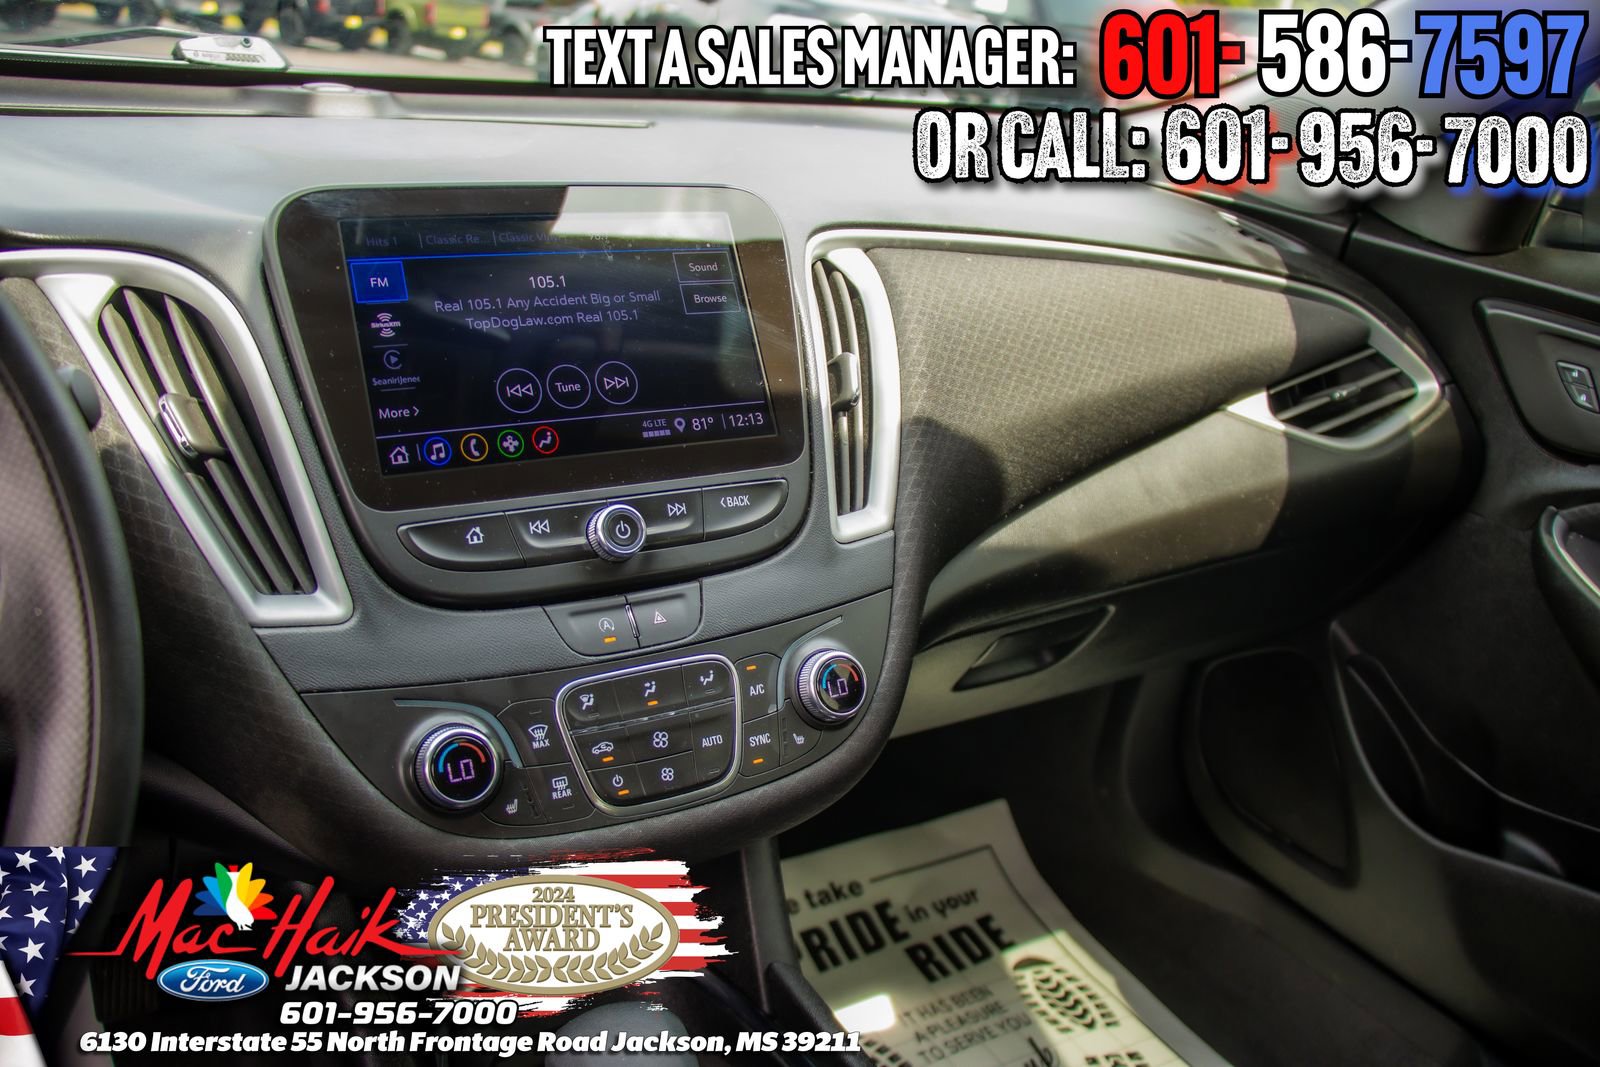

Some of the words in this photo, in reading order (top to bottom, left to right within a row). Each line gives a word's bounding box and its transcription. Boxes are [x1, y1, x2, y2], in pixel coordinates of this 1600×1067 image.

[366, 237, 389, 247] Hits
[425, 233, 463, 246] Classic
[687, 261, 718, 273] Sound
[370, 277, 389, 288] FM
[528, 275, 567, 289] 105.1
[434, 300, 464, 313] Real
[467, 298, 502, 311] 105.1
[507, 298, 530, 312] Any
[533, 294, 588, 308] Accident
[590, 293, 611, 307] Big
[613, 293, 626, 304] or
[628, 290, 661, 303] Small
[694, 293, 727, 304] Browse
[465, 315, 574, 332] TopDogLaw.com
[577, 311, 603, 323] Real
[606, 309, 639, 322] 105.1
[554, 382, 581, 393] Tune
[378, 407, 410, 420] More
[729, 412, 764, 427] 12:13
[642, 419, 653, 428] 4G
[654, 418, 667, 427] LTE
[749, 683, 765, 697] A/C
[532, 737, 551, 750] MAX
[701, 733, 723, 748] AUTO
[749, 732, 771, 748] SYNC
[551, 787, 573, 801] REAR
[803, 877, 864, 910] take
[794, 899, 911, 974] RIDE
[904, 903, 929, 923] in
[932, 887, 980, 919] your
[904, 912, 1017, 984] RIDE
[917, 995, 952, 1021] HAS
[926, 1001, 1009, 1038] PLEASURE
[917, 1043, 946, 1066] TO
[944, 1024, 998, 1056] SERVE
[996, 1012, 1034, 1037] YOU
